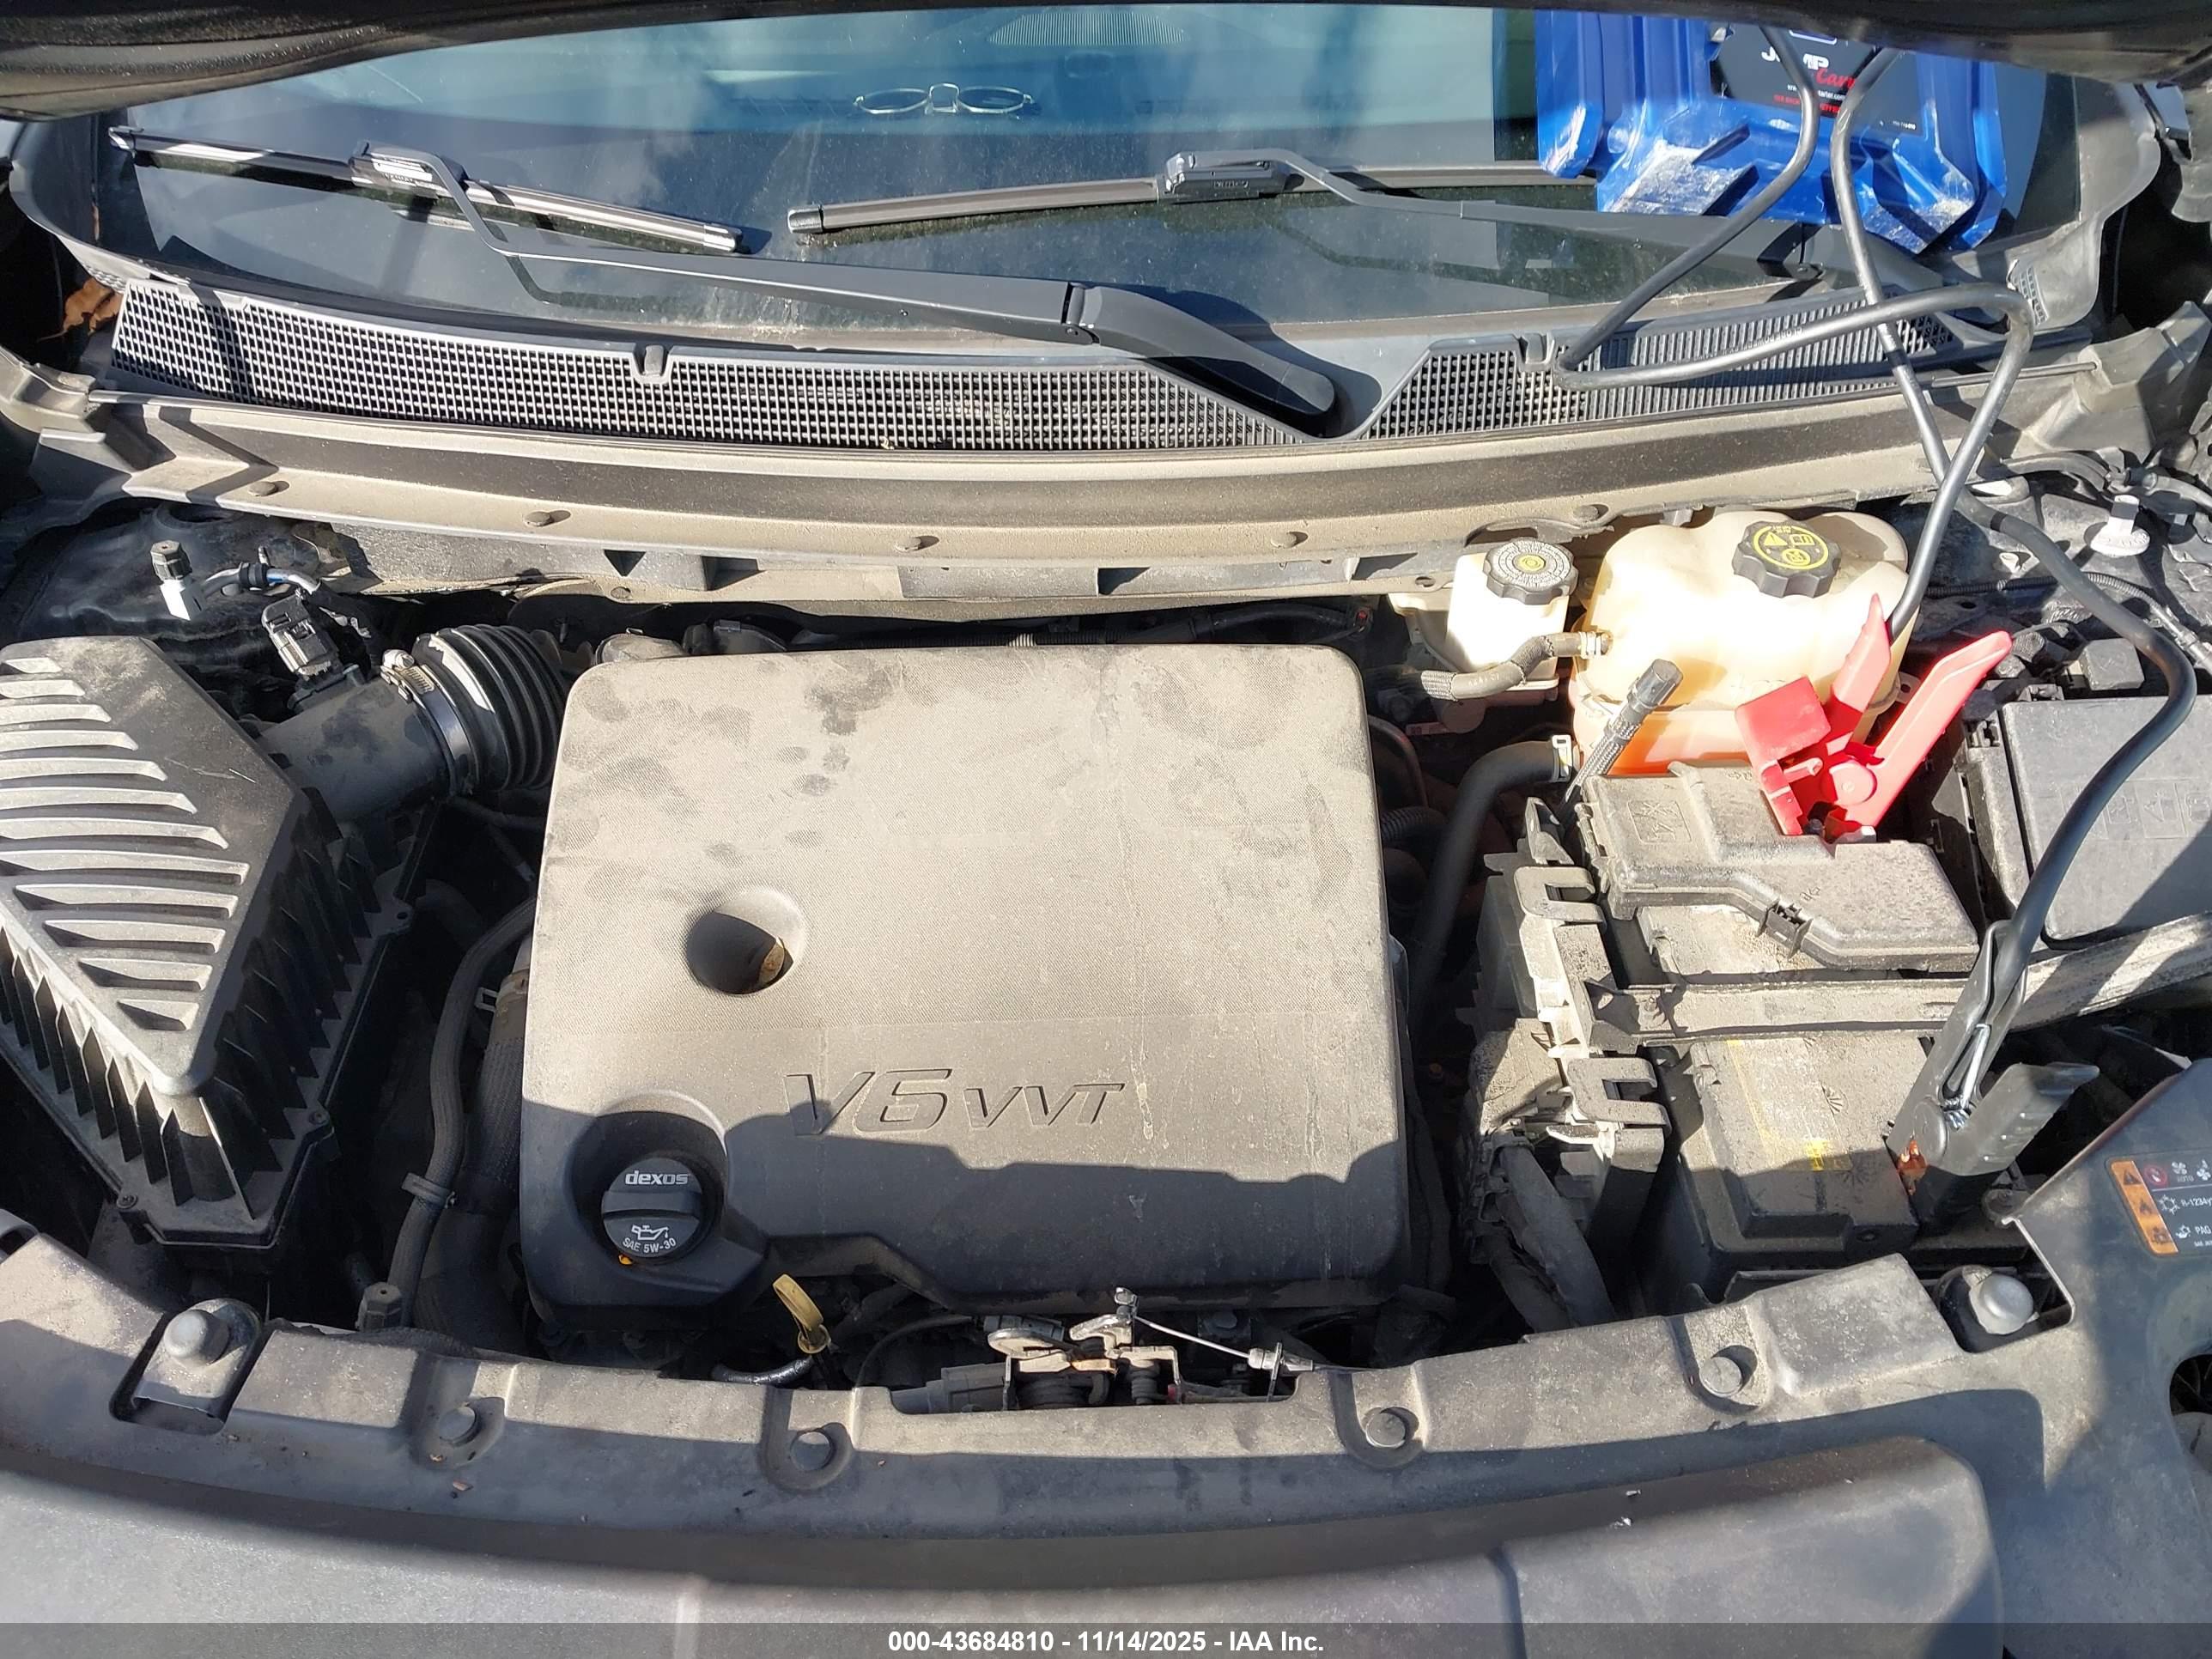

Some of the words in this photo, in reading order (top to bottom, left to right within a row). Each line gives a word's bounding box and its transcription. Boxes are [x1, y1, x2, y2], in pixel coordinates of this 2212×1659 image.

[1761, 46, 1829, 70] JMP
[783, 1067, 952, 1135] V6
[963, 1084, 1125, 1127] VVT
[625, 1170, 689, 1185] dexos
[622, 1237, 641, 1252] SAE
[643, 1237, 677, 1254] 5W-30
